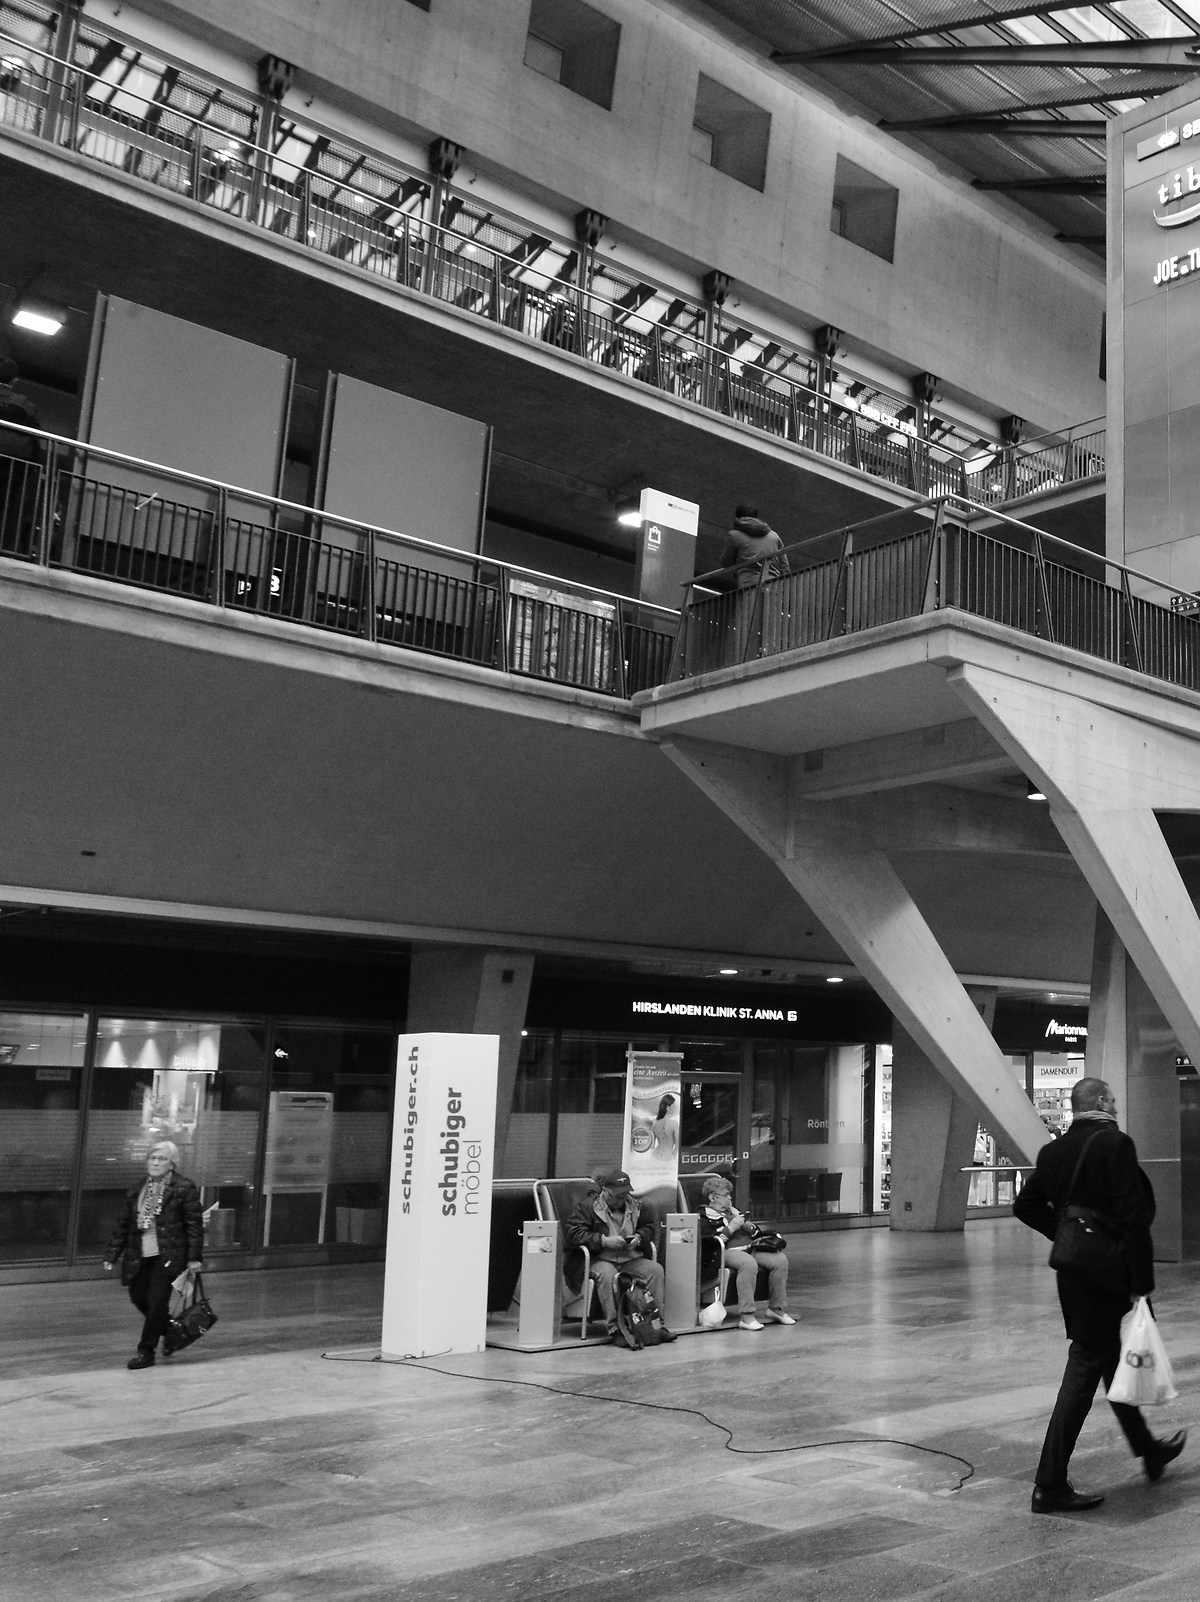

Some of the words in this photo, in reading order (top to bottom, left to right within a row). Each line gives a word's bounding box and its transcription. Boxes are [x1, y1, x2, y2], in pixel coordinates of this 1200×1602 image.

[1153, 255, 1179, 285] JOE
[632, 1001, 702, 1016] HIRSLANDEN
[703, 1006, 737, 1018] KLINIK
[738, 1008, 754, 1019] ST.
[754, 1009, 784, 1021] ANNA
[1040, 1066, 1078, 1076] DAMENDUFT
[402, 1045, 420, 1215] schubiger.ch
[807, 1119, 845, 1130] Rönten
[438, 1086, 467, 1217] schubiger
[461, 1140, 482, 1216] möbel
